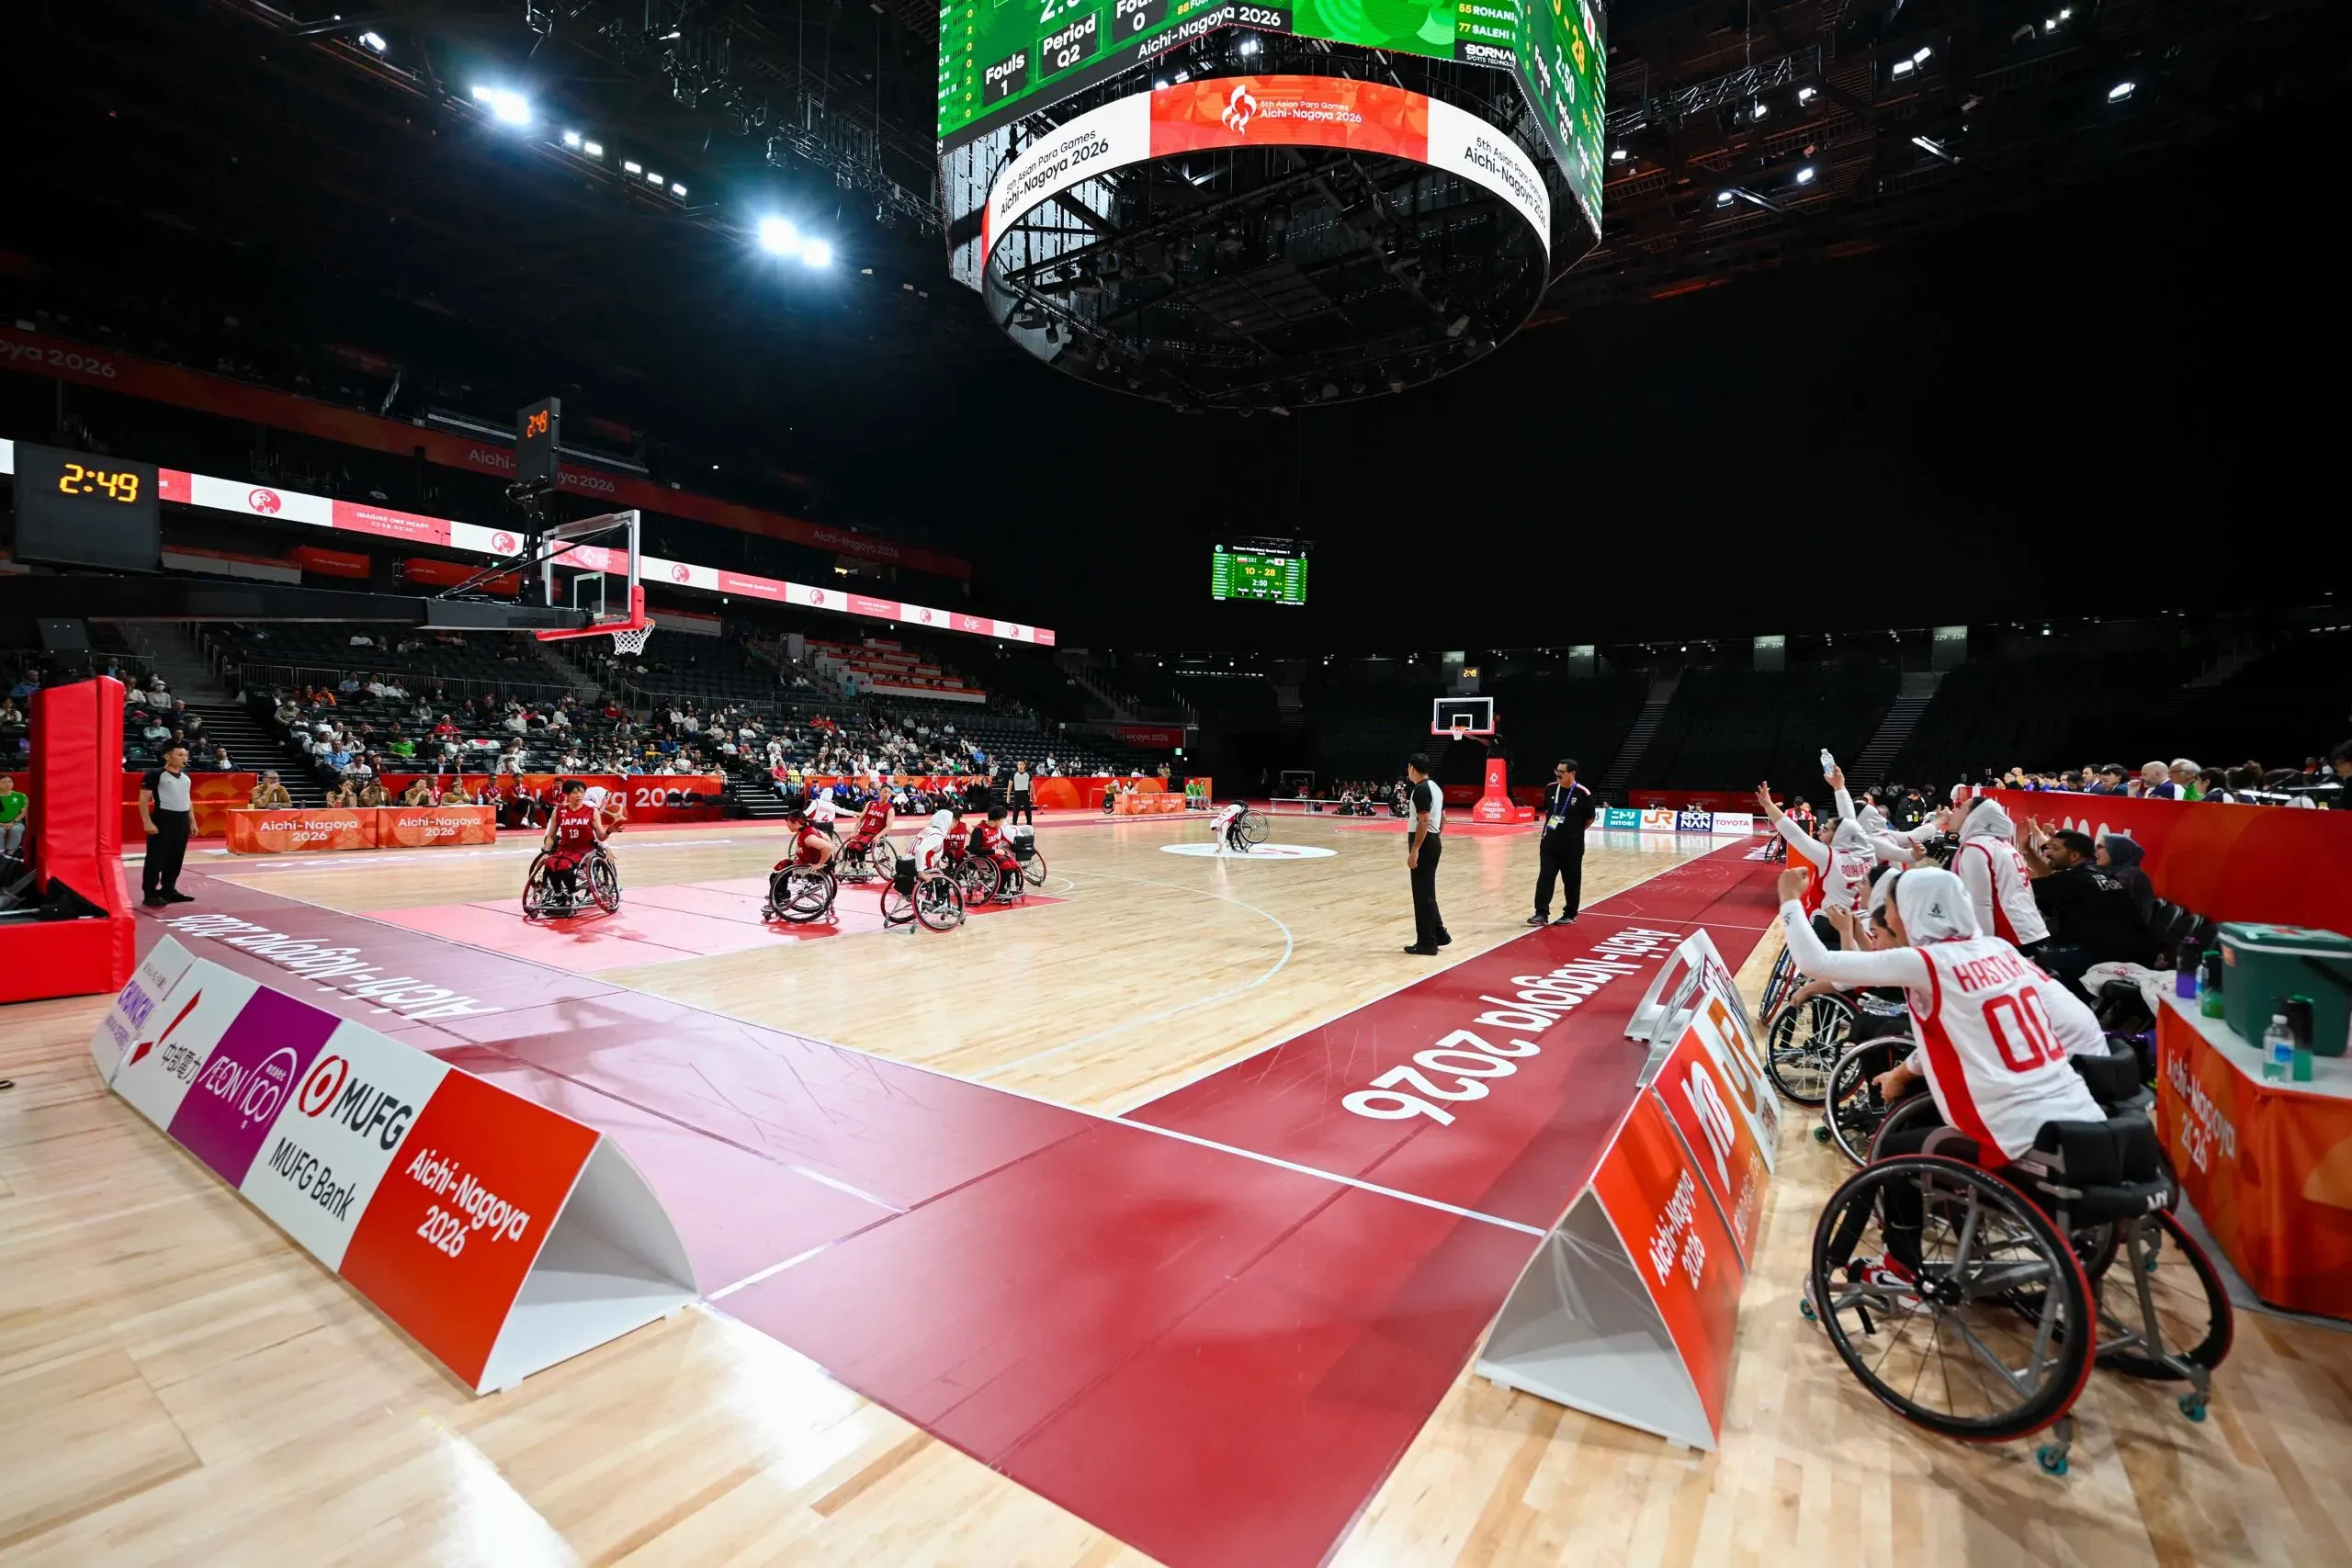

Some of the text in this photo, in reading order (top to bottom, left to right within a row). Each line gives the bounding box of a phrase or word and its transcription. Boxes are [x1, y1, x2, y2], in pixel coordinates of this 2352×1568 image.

[1133, 12, 1146, 31] 0
[1177, 3, 1190, 15] 88
[1043, 13, 1096, 56] Period
[1137, 6, 1281, 59] Aichi-Nagoya 2026
[1459, 22, 1510, 39] 77 SALEHI
[1057, 44, 1080, 68] Q2
[1571, 25, 1586, 74] 28
[985, 53, 1025, 85] Fouls
[1001, 80, 1008, 96] 1
[1260, 108, 1363, 123] Aichi-Nagoya 2026
[1300, 101, 1318, 109] Para
[1321, 102, 1349, 111] Games
[1018, 161, 1036, 184] Asian
[1038, 149, 1057, 167] Para
[1060, 130, 1097, 153] Games
[1476, 137, 1492, 152] 5th
[1493, 147, 1514, 167] Asian
[1001, 138, 1110, 219] Aichi-Nagoya 2026
[1464, 146, 1533, 207] Aichi-Nagoya
[48, 349, 118, 378] 2026
[526, 410, 548, 438] 2:49
[59, 463, 139, 502] 2:49
[579, 476, 615, 493] 2026
[356, 512, 430, 530] IMAGINE ONE HEART
[812, 530, 876, 555] Aichi-Nagoya
[1245, 567, 1256, 575] 10
[1264, 569, 1276, 577] 28
[1151, 734, 1170, 742] 2026
[260, 819, 358, 832] Aichi-Nagoya
[399, 817, 481, 830] Aichi-Nagoya
[868, 809, 885, 818] JAPAN
[1611, 810, 1635, 821] ニトリ
[1645, 811, 1674, 825] JR
[1715, 818, 1750, 828] TOYOTA
[292, 831, 328, 842] 2026
[424, 827, 456, 837] 2026
[155, 914, 271, 937] 2026
[224, 932, 506, 1021] Aichi-Nagoya
[1341, 926, 1681, 1127] Aichi-Nagoya 2026
[1981, 985, 2065, 1073] 00
[161, 1041, 203, 1085] 中部電力
[330, 1076, 413, 1152] MUFG
[268, 1136, 356, 1224] MUFG Bank
[405, 1147, 530, 1244] Aichi-Nagoya
[416, 1204, 468, 1258] 2026
[1648, 1168, 1697, 1288] Aichi-Nagoya
[1680, 1226, 1706, 1291] 2026
